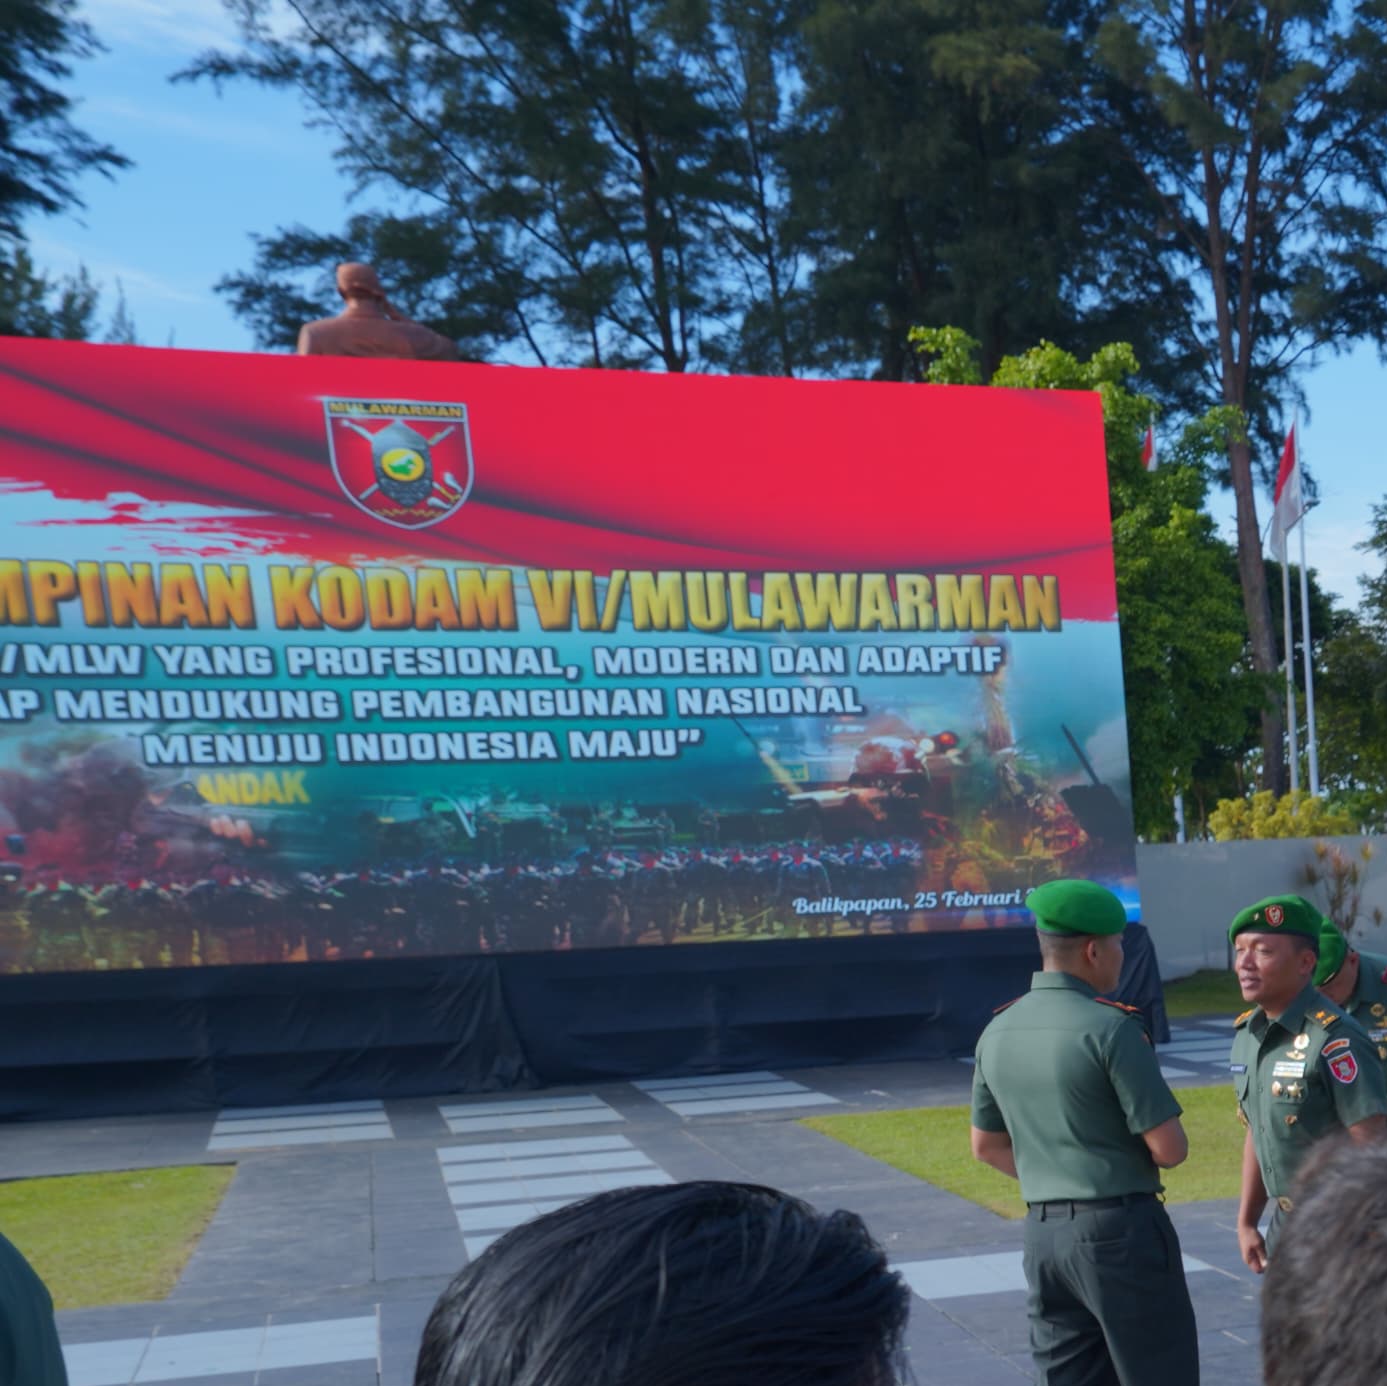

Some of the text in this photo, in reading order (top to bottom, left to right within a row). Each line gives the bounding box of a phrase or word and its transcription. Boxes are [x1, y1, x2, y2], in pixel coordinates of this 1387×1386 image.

[268, 565, 517, 630] KODAM
[527, 569, 1061, 632] VI/MULAWARMAN
[154, 645, 273, 676] YANG
[286, 646, 580, 680] PROFESIONAL,
[593, 646, 758, 675] MODERN
[770, 645, 846, 674] DAN
[857, 645, 1002, 674] ADAPTIF
[54, 689, 340, 720] MENDUKUNG
[351, 688, 665, 719] PEMBANGUNAN
[676, 686, 863, 715] NASIONAL
[142, 733, 323, 764] MENUJU
[335, 731, 558, 763] INDONESIA
[792, 896, 910, 917] Balikpapan,
[914, 891, 938, 909] 25
[940, 886, 1024, 908] Februari
